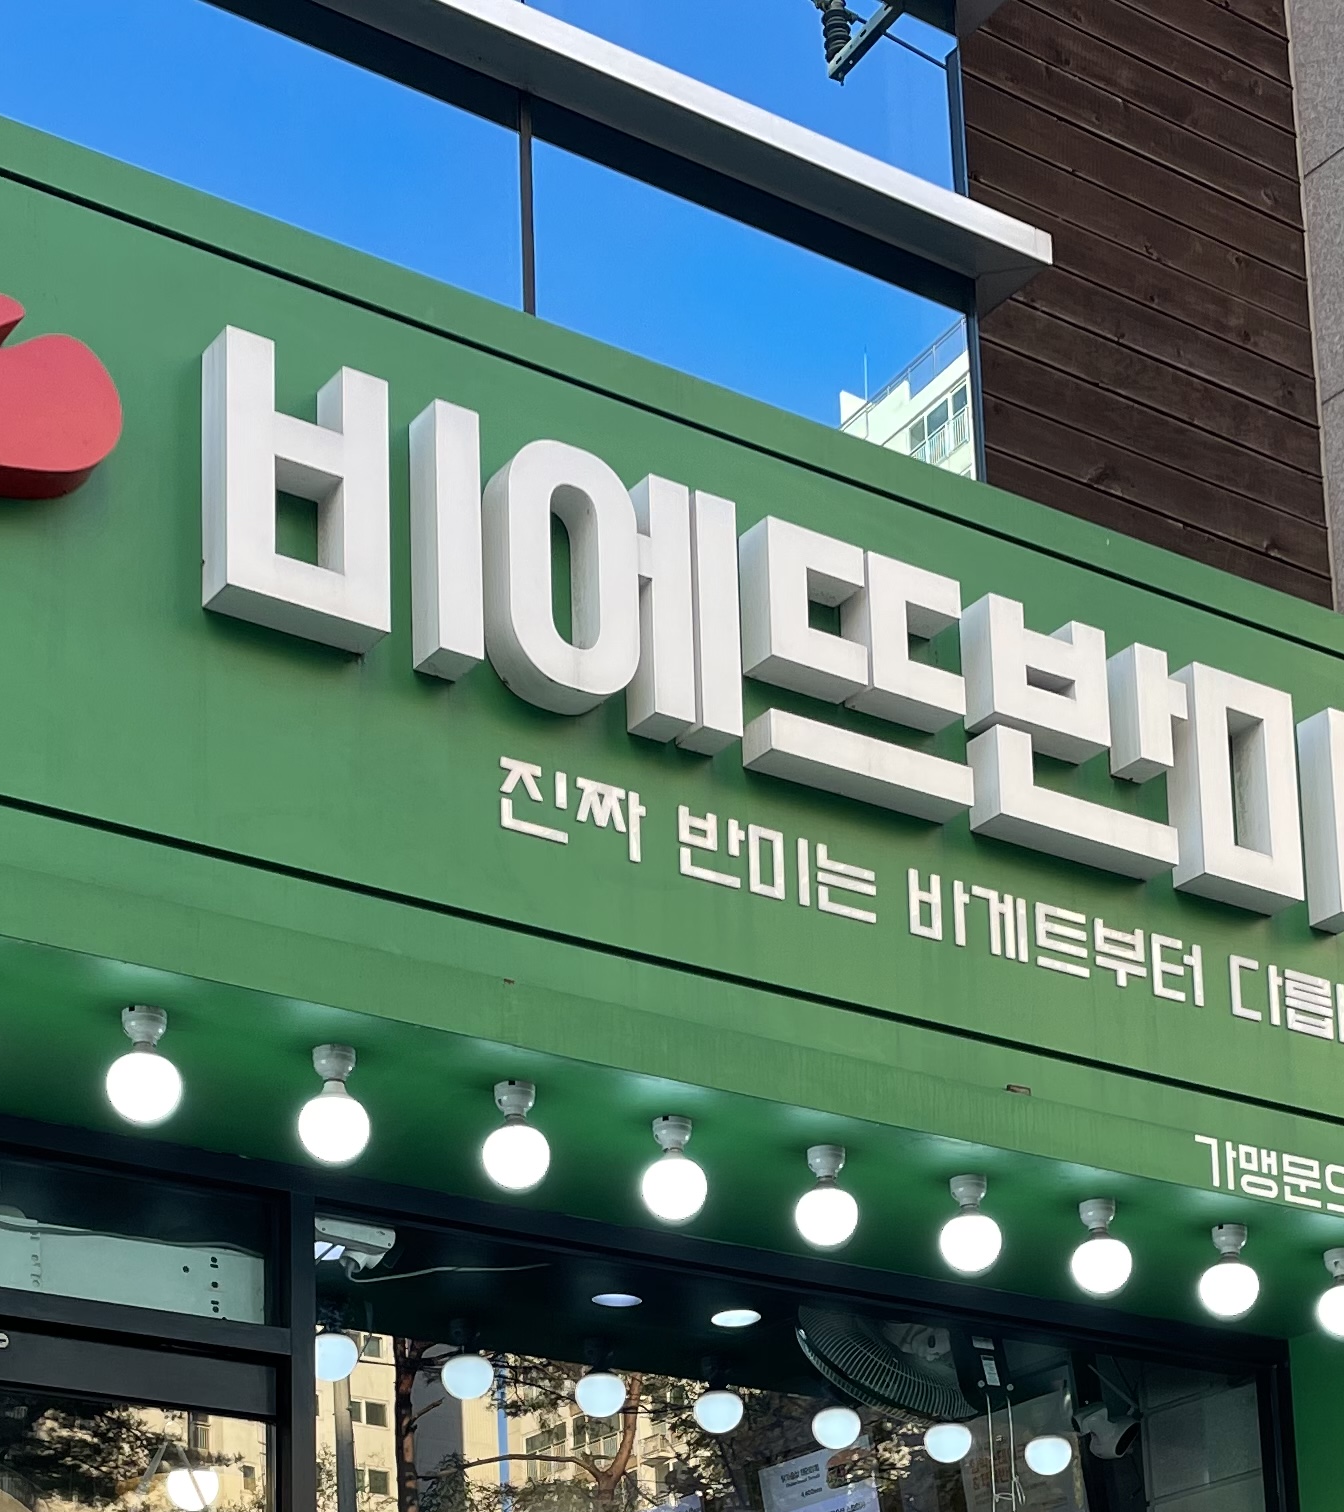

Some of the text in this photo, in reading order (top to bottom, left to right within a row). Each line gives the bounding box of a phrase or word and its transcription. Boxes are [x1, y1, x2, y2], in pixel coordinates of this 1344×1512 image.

[499, 756, 646, 863] 진짜
[677, 804, 877, 923] 반미는
[907, 868, 1205, 1007] 바게트부터
